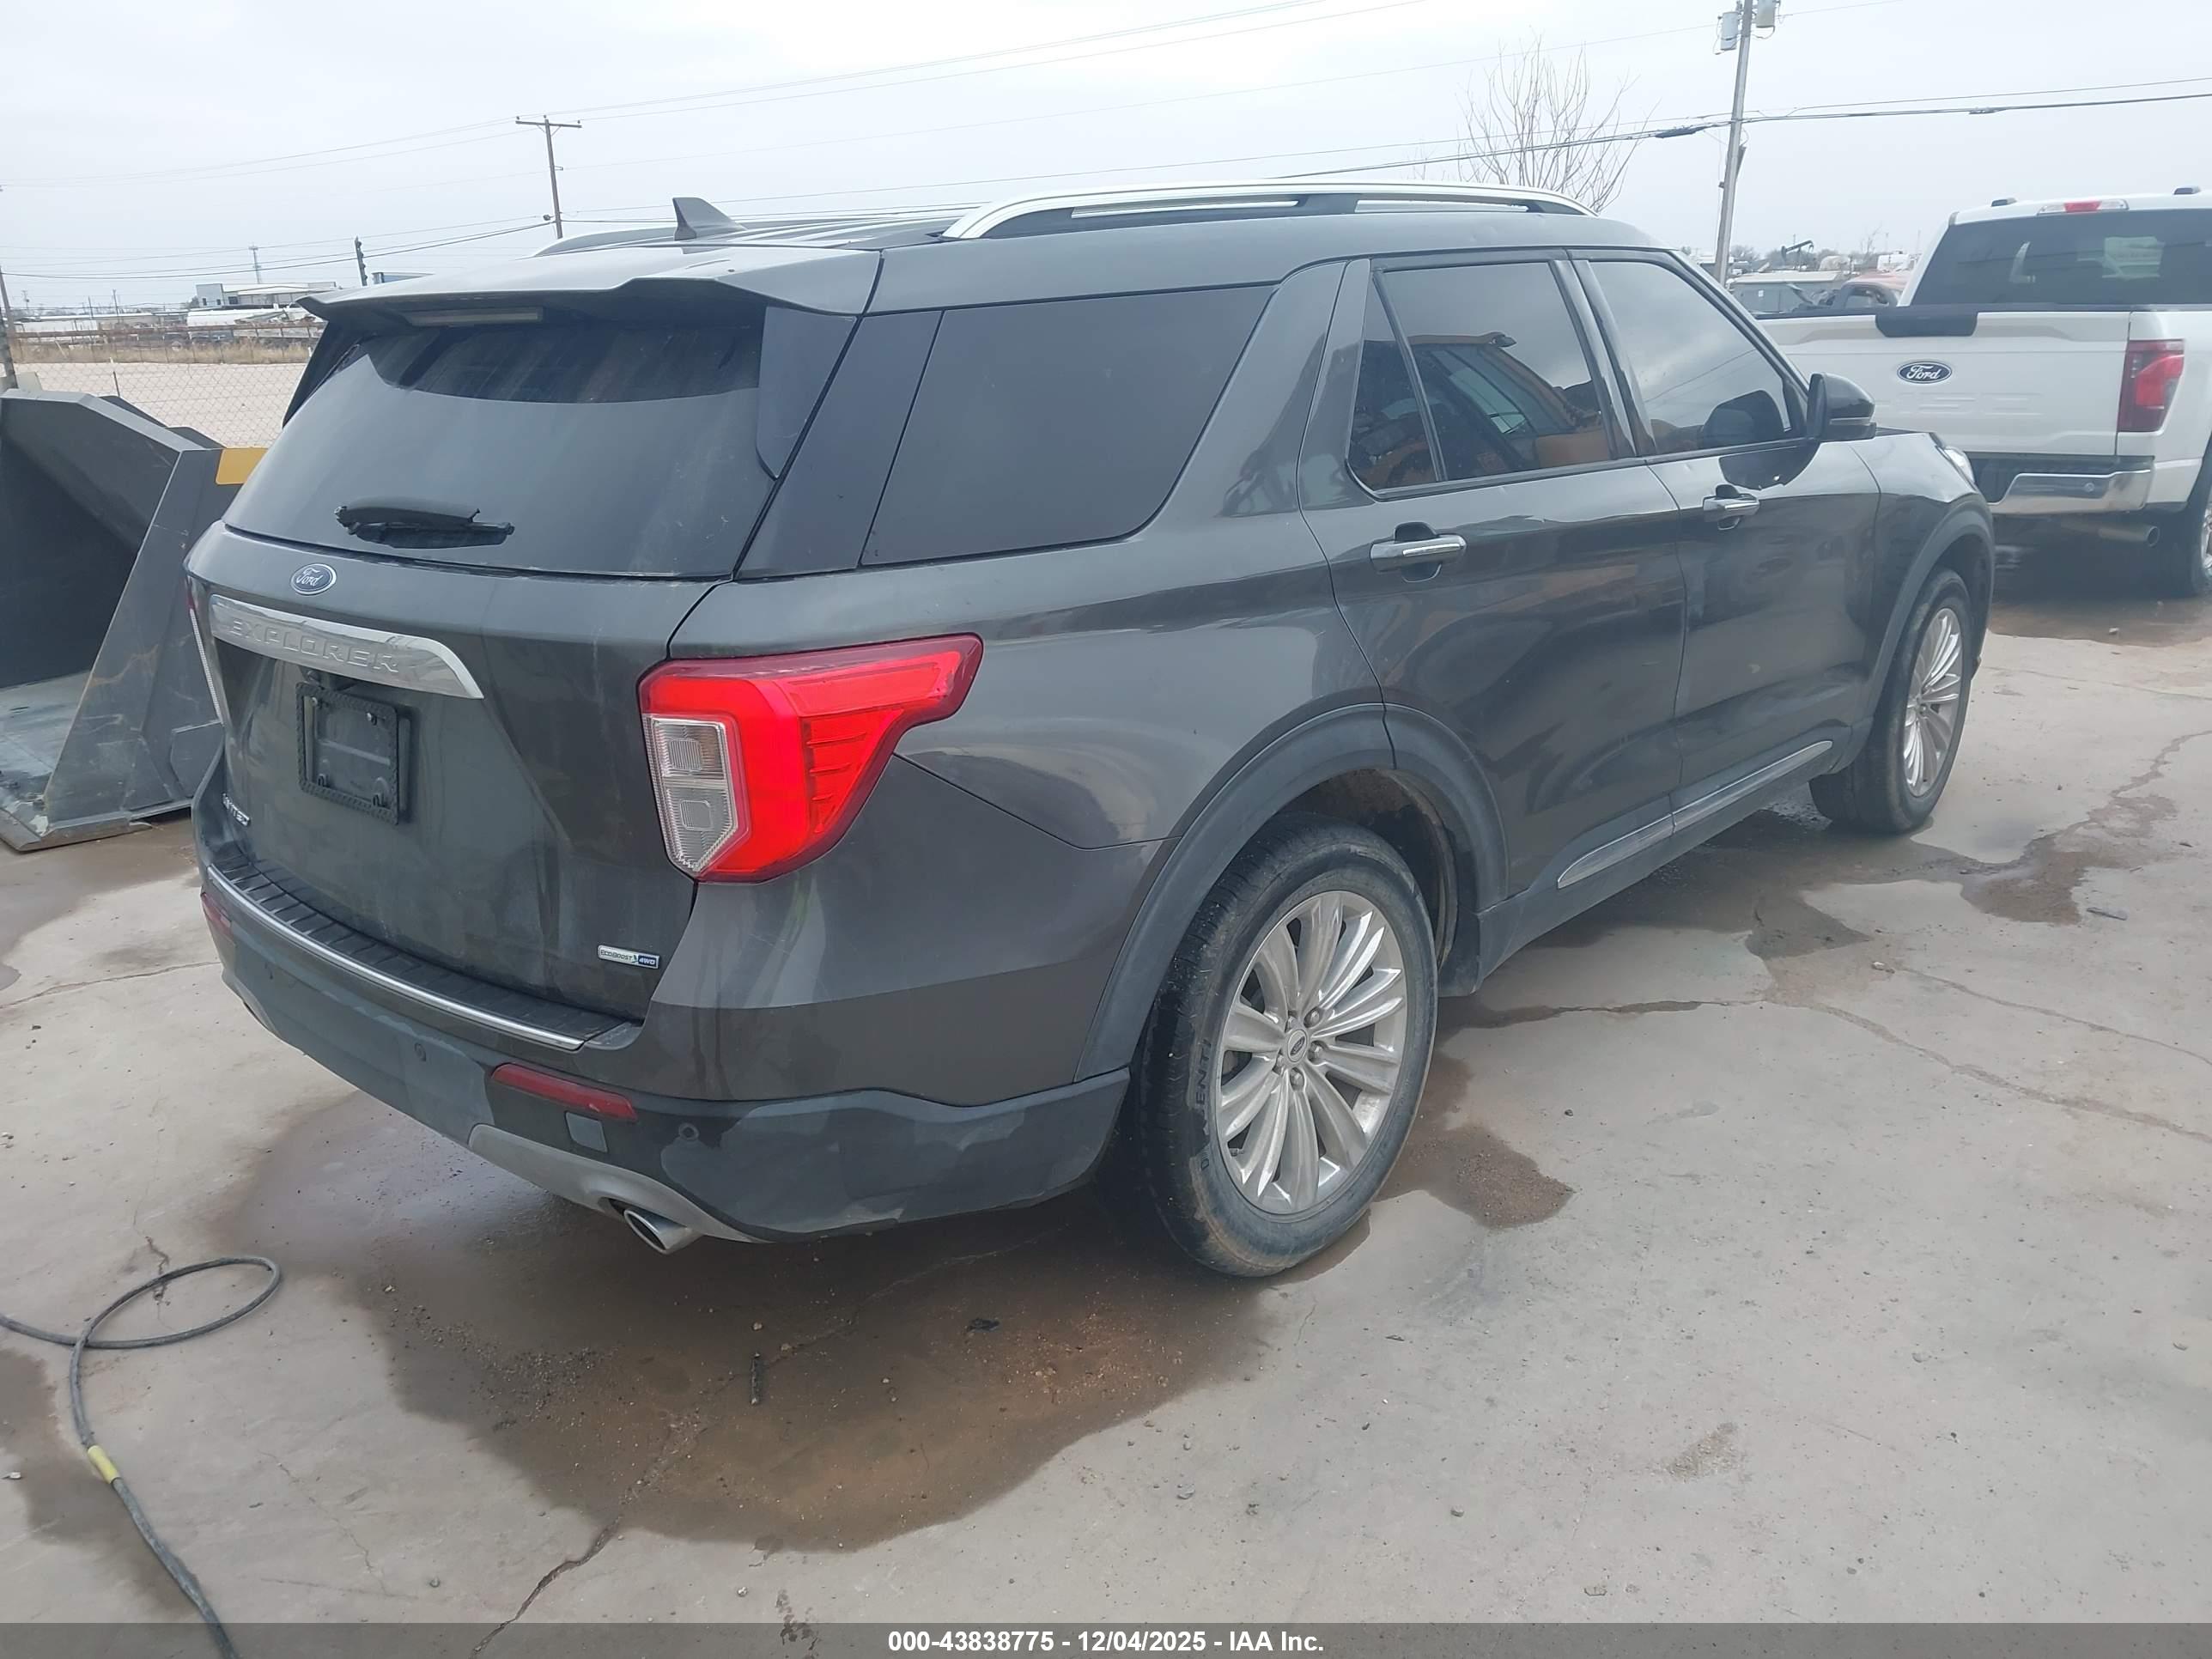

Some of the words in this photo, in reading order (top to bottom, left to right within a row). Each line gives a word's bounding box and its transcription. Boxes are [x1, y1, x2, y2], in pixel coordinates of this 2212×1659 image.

[1905, 362, 1943, 380] Ford
[295, 567, 324, 586] Ford
[229, 618, 399, 673] EXPLORER
[638, 957, 656, 965] 4WD
